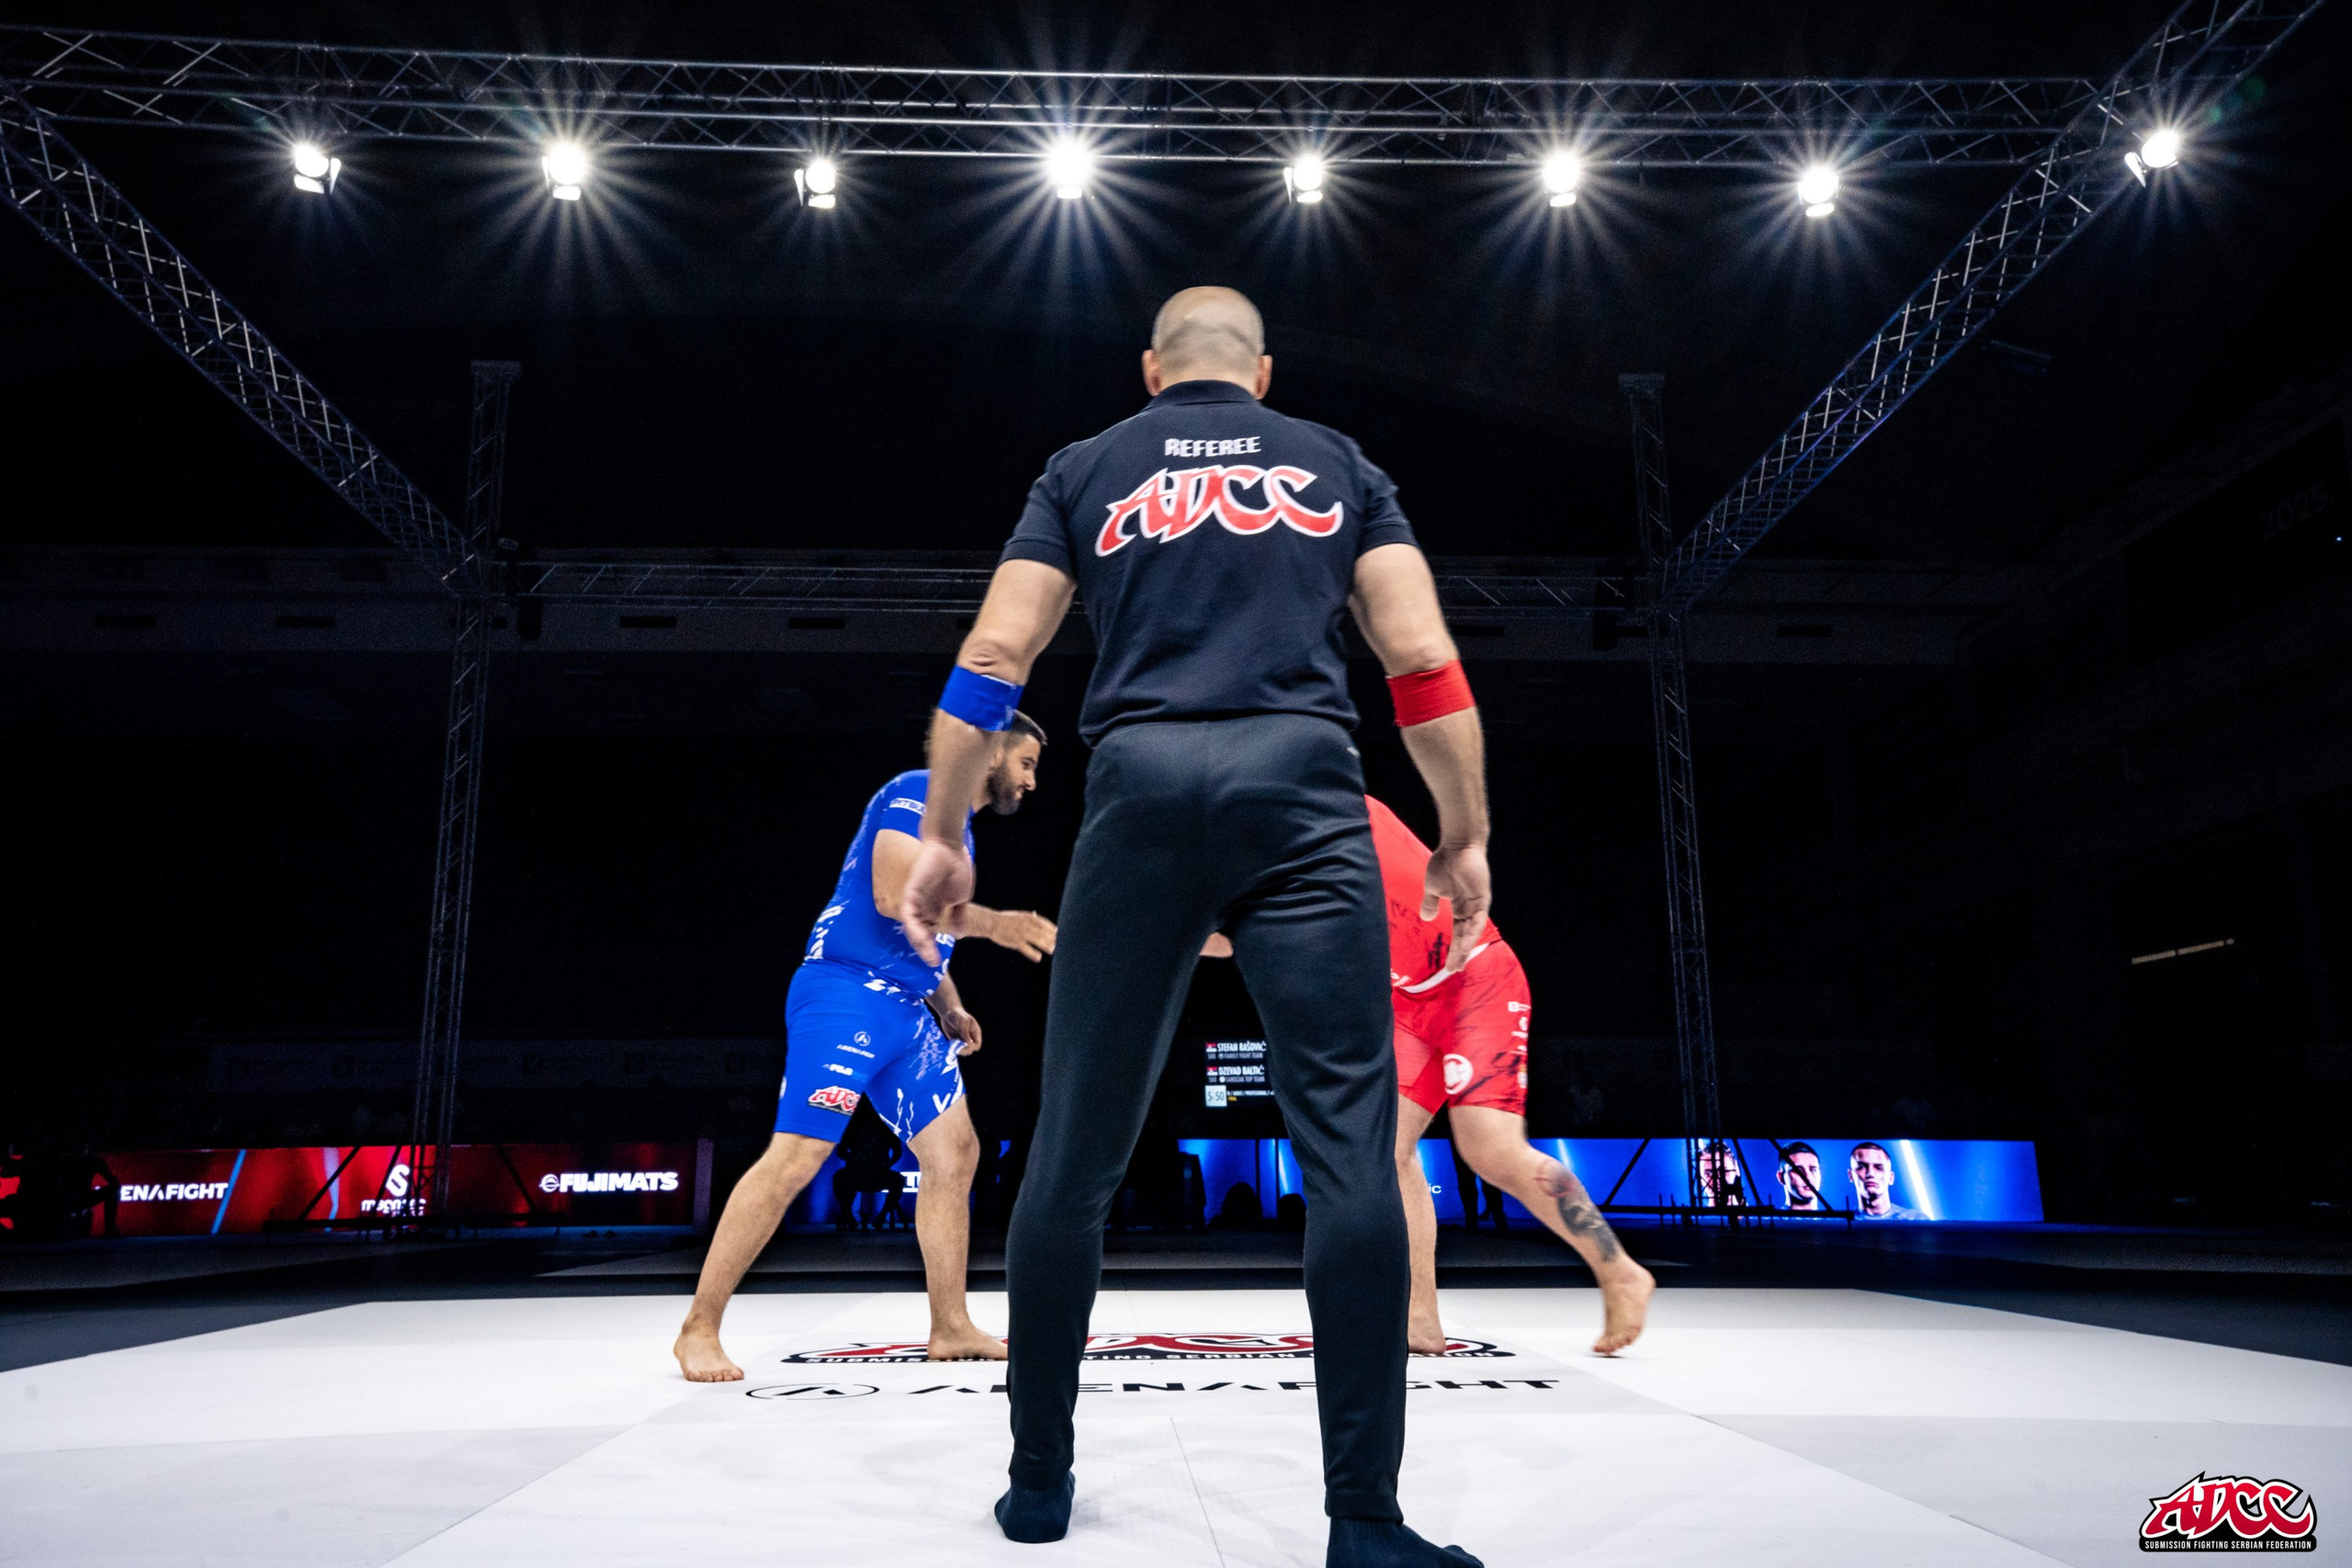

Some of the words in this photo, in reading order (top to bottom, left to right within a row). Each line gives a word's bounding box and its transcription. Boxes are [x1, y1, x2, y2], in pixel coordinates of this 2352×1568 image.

[1164, 436, 1261, 457] REFEREE
[1095, 465, 1344, 557] ADCC
[808, 1086, 861, 1111] ADC
[559, 1172, 679, 1192] FUJIMATS
